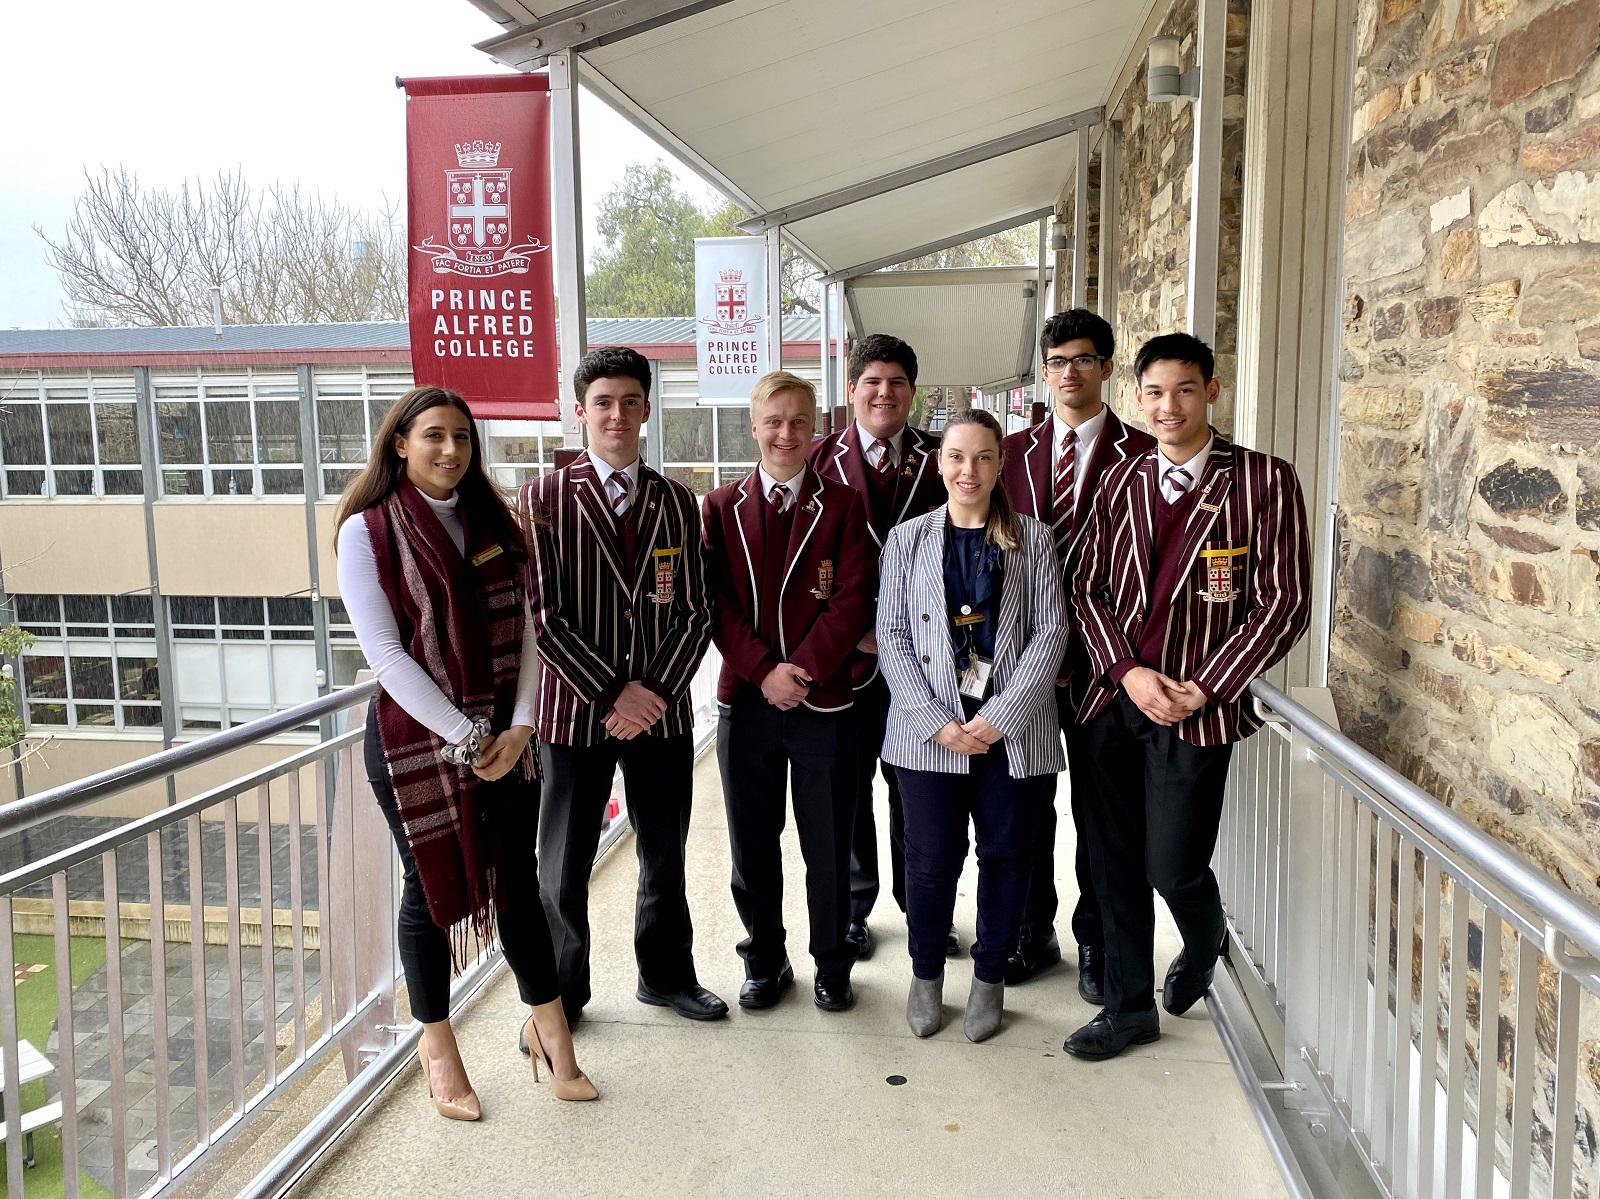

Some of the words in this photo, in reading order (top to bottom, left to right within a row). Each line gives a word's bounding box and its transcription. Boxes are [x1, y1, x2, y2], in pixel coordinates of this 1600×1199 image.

[469, 254, 492, 262] 1869
[435, 259, 451, 267] FAC
[453, 262, 482, 274] FORTIA
[485, 266, 494, 274] ET
[497, 259, 525, 271] PATERE
[431, 289, 532, 310] PRINCE
[433, 315, 533, 335] ALFRED
[434, 339, 533, 357] COLLEGE
[708, 341, 757, 351] PRINCE
[709, 353, 757, 364] ALFRED
[709, 365, 757, 374] COLLEGE
